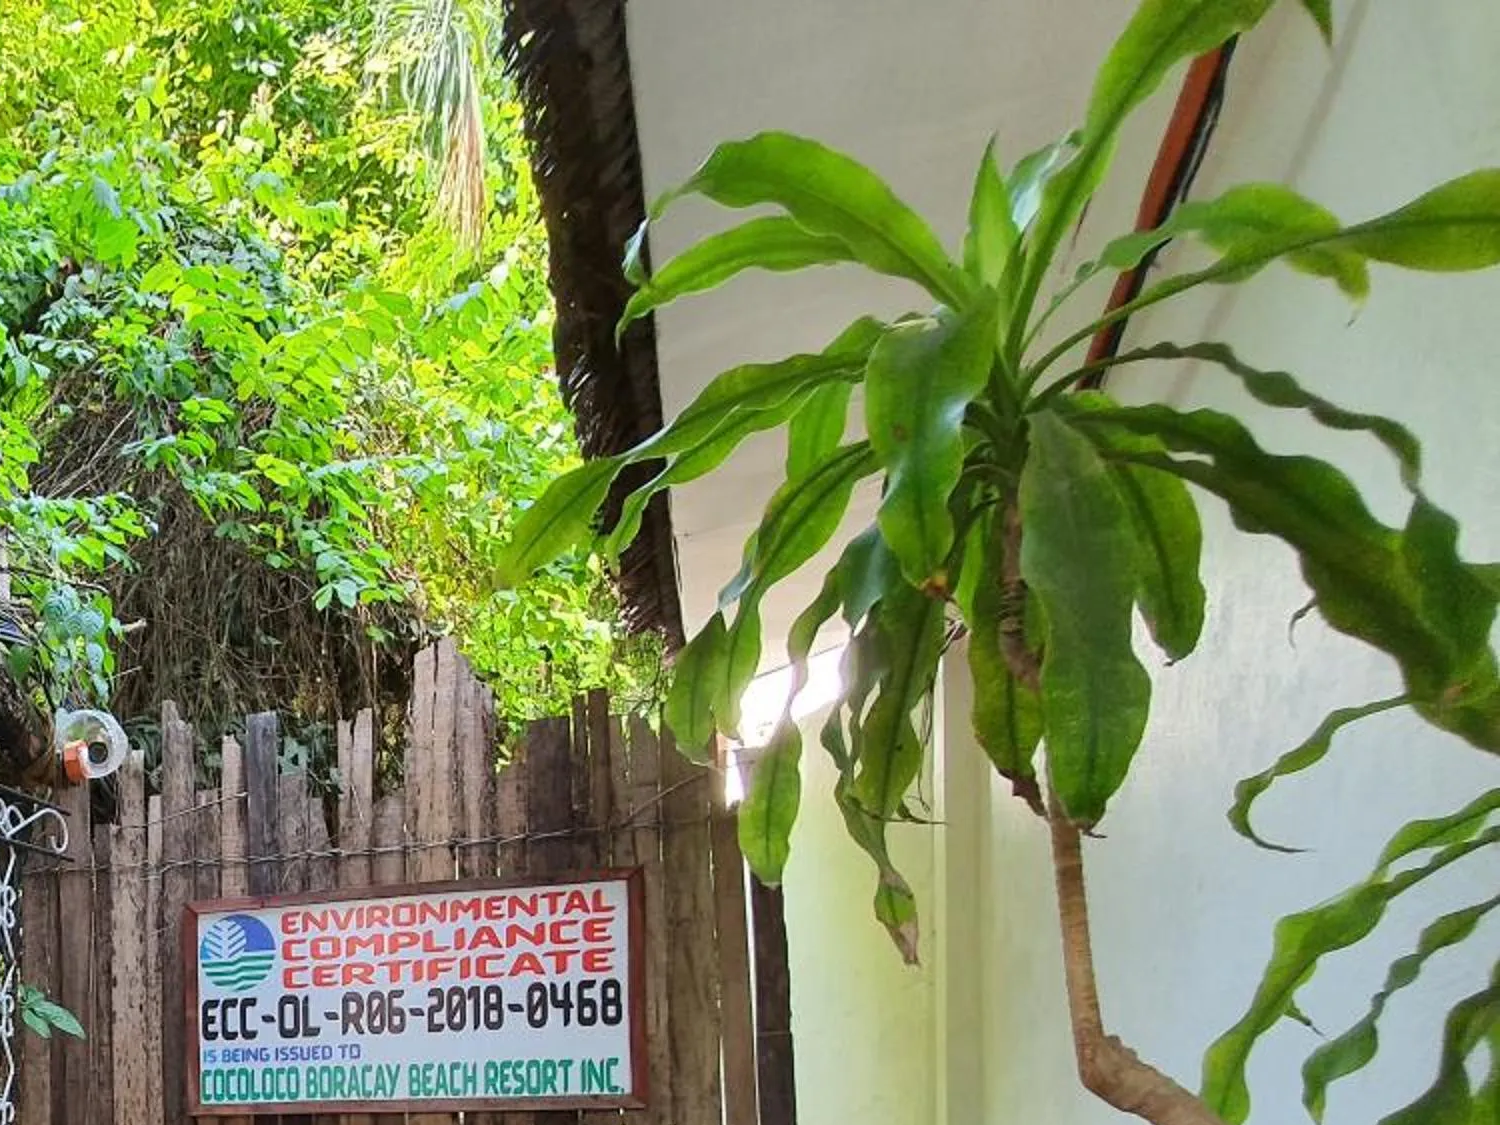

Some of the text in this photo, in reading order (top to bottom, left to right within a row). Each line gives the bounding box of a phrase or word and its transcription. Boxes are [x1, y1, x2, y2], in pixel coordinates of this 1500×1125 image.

[280, 888, 615, 935] ENVIRONMENTAL
[281, 916, 615, 961] COMPLIANCE
[282, 947, 615, 990] CERTIFICATE
[202, 979, 623, 1041] ECC-OL-R06-2018-0468
[203, 1043, 362, 1063] IS BEING ISSUED TO
[202, 1056, 626, 1101] COCOLOCO BORACAY BEACH RESORT INC.
